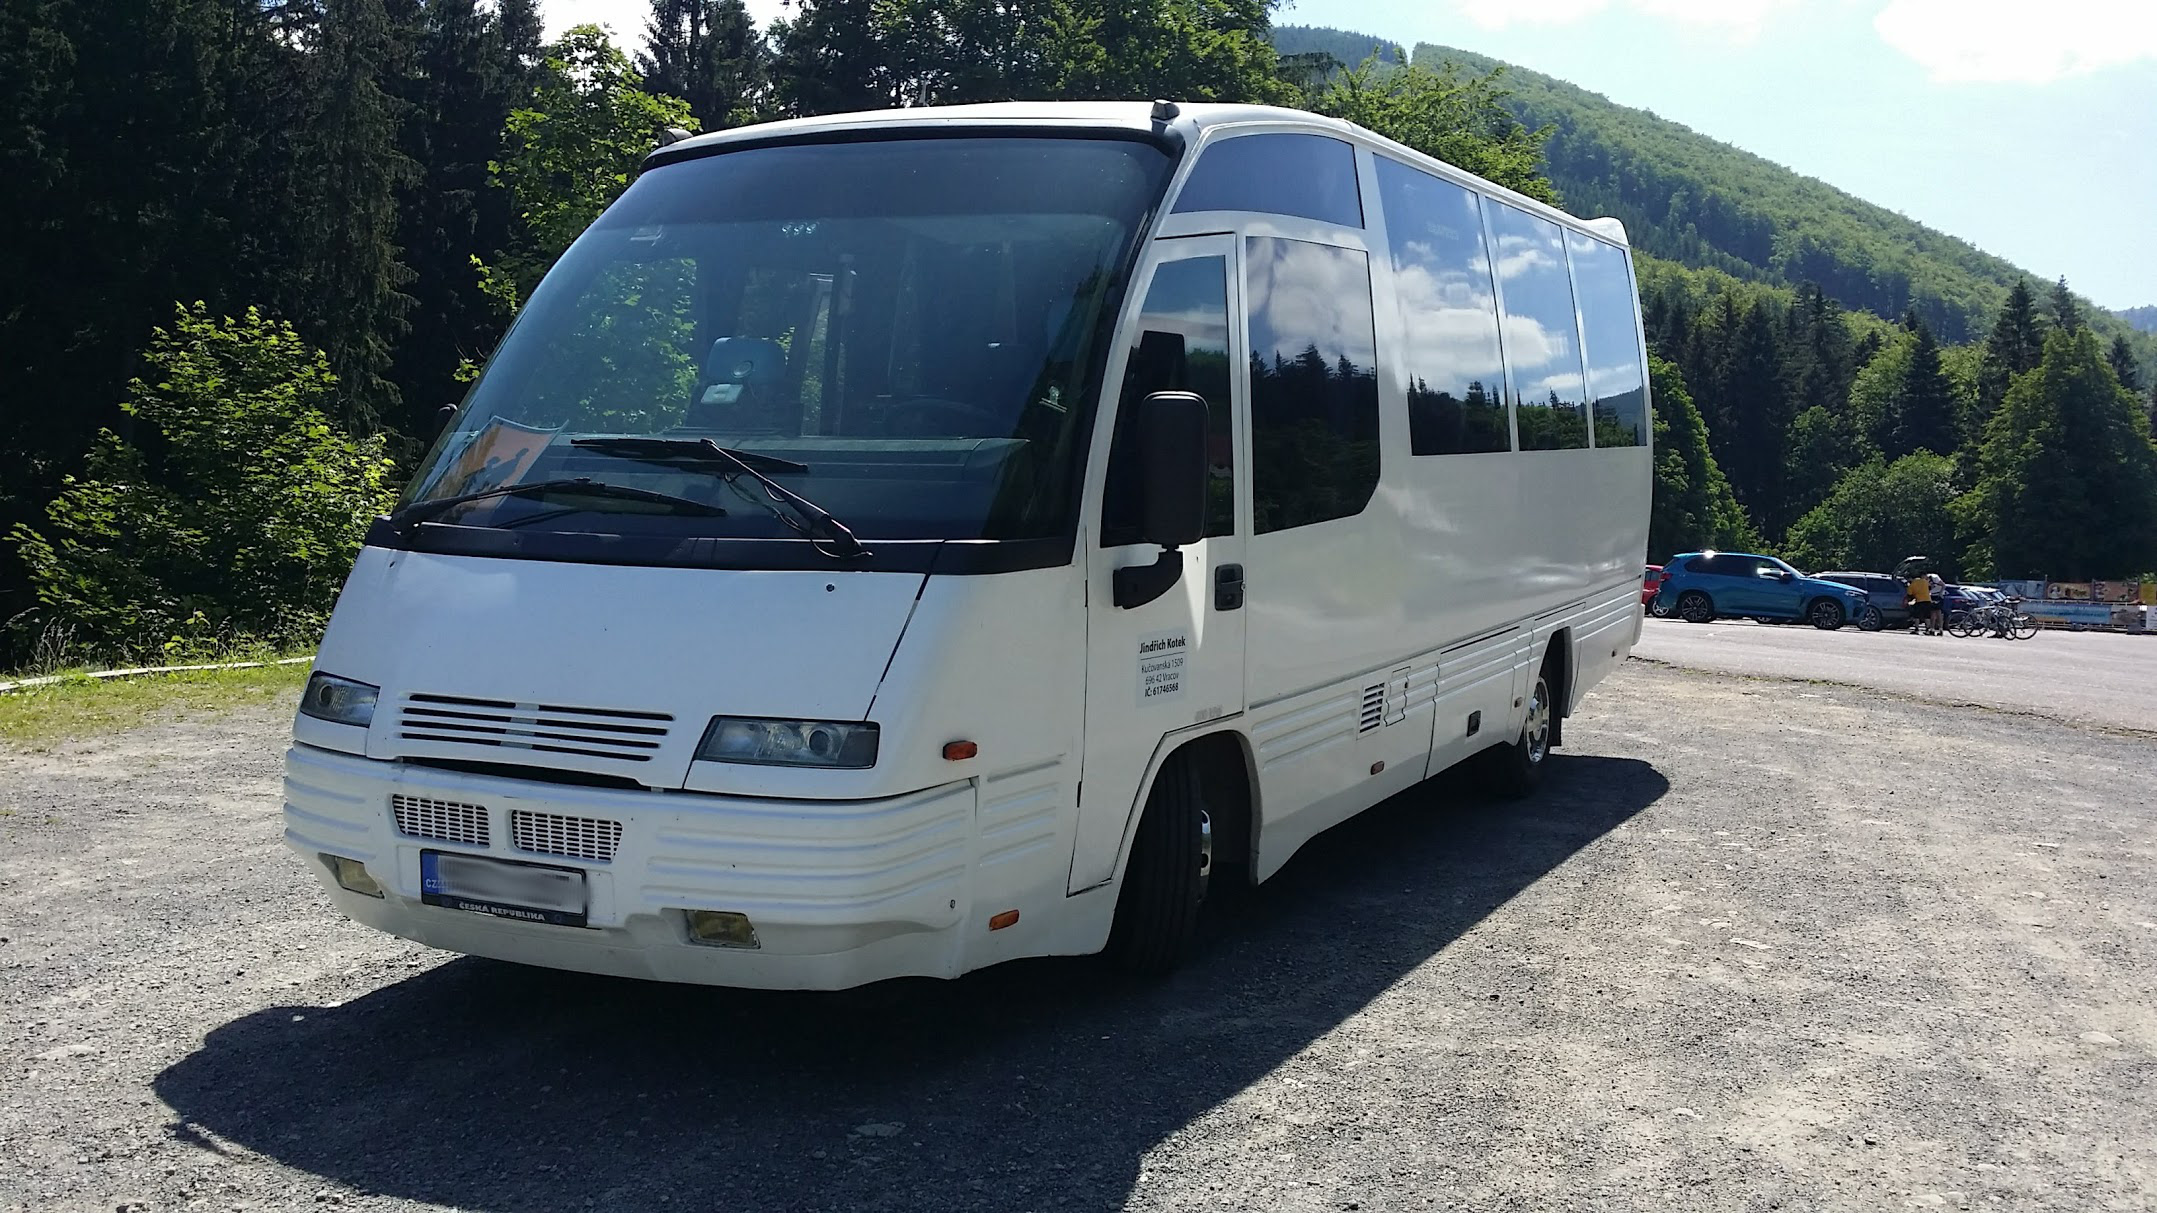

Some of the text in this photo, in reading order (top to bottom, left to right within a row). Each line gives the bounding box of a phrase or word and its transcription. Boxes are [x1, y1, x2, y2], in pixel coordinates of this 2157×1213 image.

[1139, 635, 1186, 654] Jindřich Kotek
[1171, 657, 1183, 667] 1509
[1156, 673, 1162, 682] 42
[1163, 672, 1179, 681] Vracov
[1144, 682, 1179, 697] IČ: 61746568
[425, 878, 437, 889] CZ
[459, 901, 546, 921] ČESKÁ REPUBLIKA
